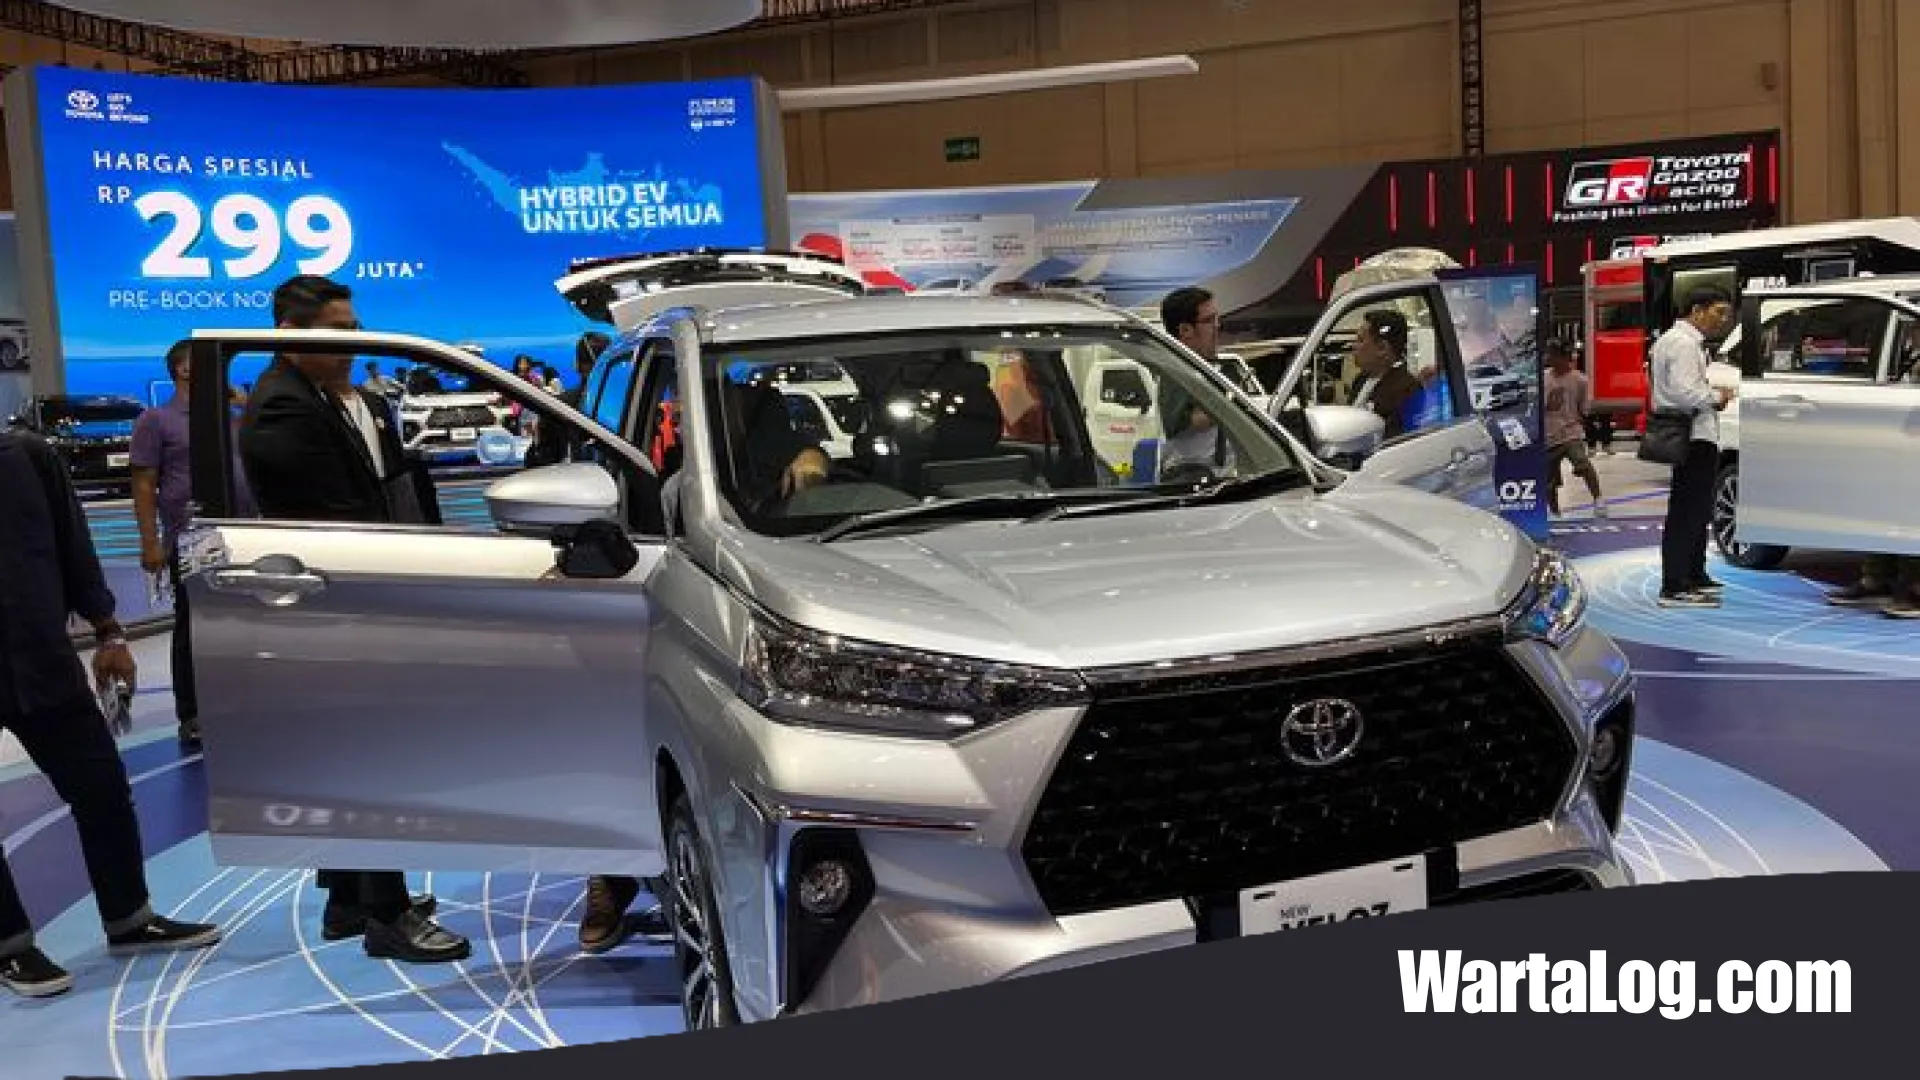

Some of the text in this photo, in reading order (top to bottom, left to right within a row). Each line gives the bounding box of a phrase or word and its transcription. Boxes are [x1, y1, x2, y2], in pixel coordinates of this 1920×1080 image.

[93, 150, 314, 179] HARGA SPESIAL
[1656, 153, 1751, 171] TOYOTA
[1653, 167, 1740, 185] GAZOO
[97, 184, 133, 204] RP
[519, 180, 668, 209] HYBRID EV
[1569, 177, 1644, 203] GR
[522, 203, 723, 233] UNTUK SEMUA
[133, 191, 353, 278] 299
[109, 289, 274, 309] PRE-BOOK NO
